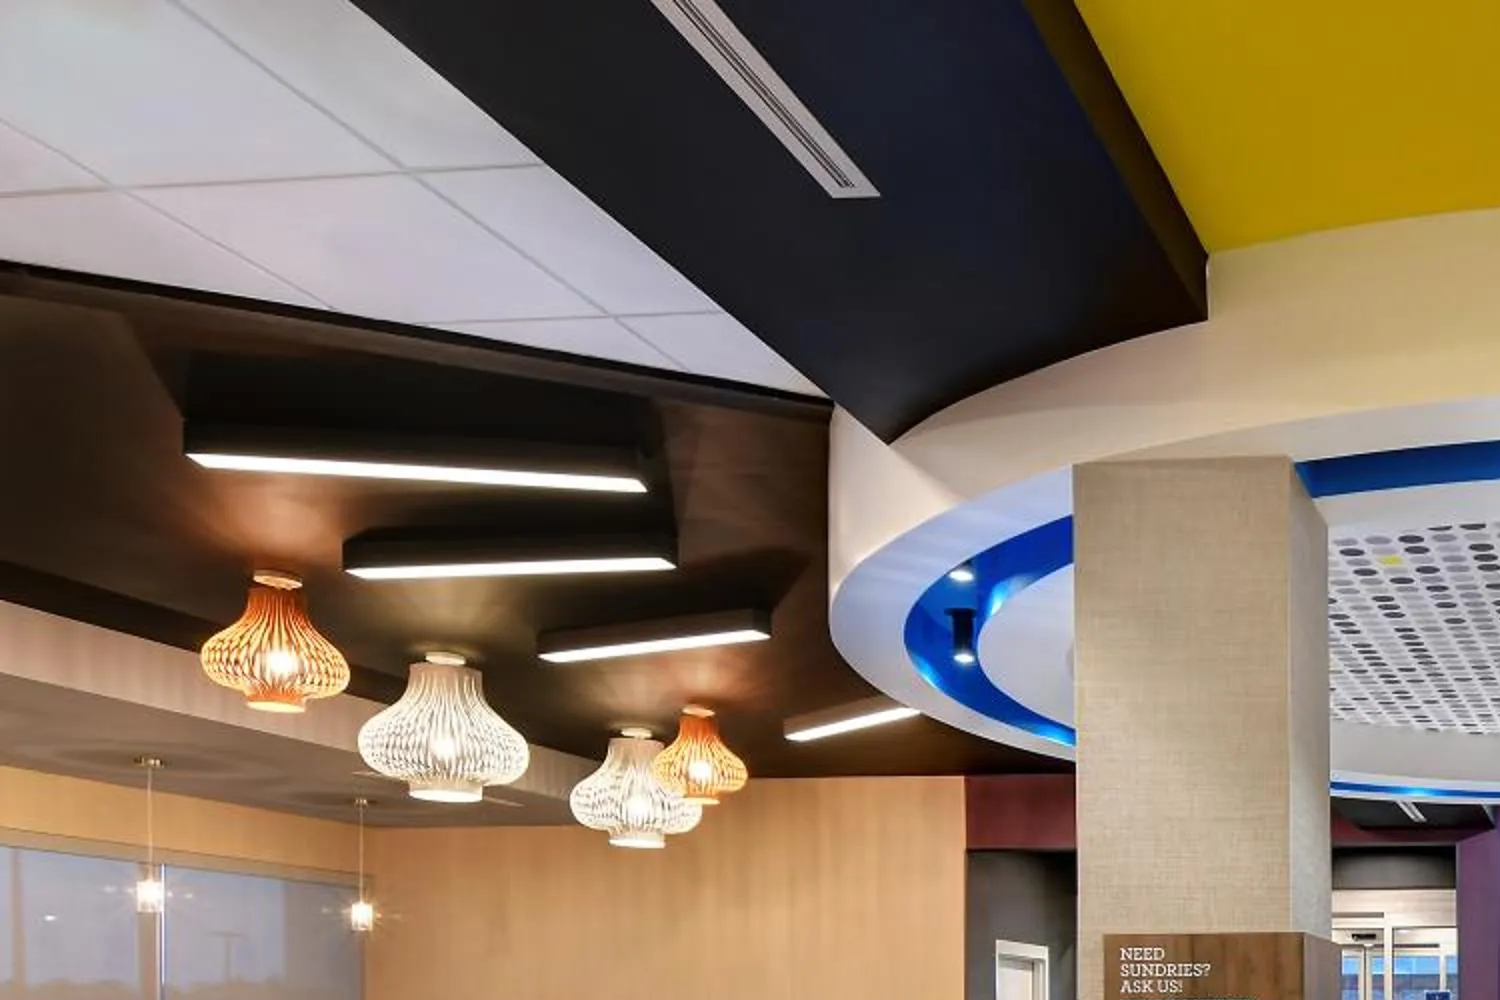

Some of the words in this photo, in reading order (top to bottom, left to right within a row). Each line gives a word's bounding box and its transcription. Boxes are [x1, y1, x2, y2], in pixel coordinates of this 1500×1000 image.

[1120, 947, 1165, 961] NEED
[1120, 963, 1211, 977] SUNDRIES?
[1120, 980, 1154, 994] ASK
[1157, 979, 1184, 993] US!
